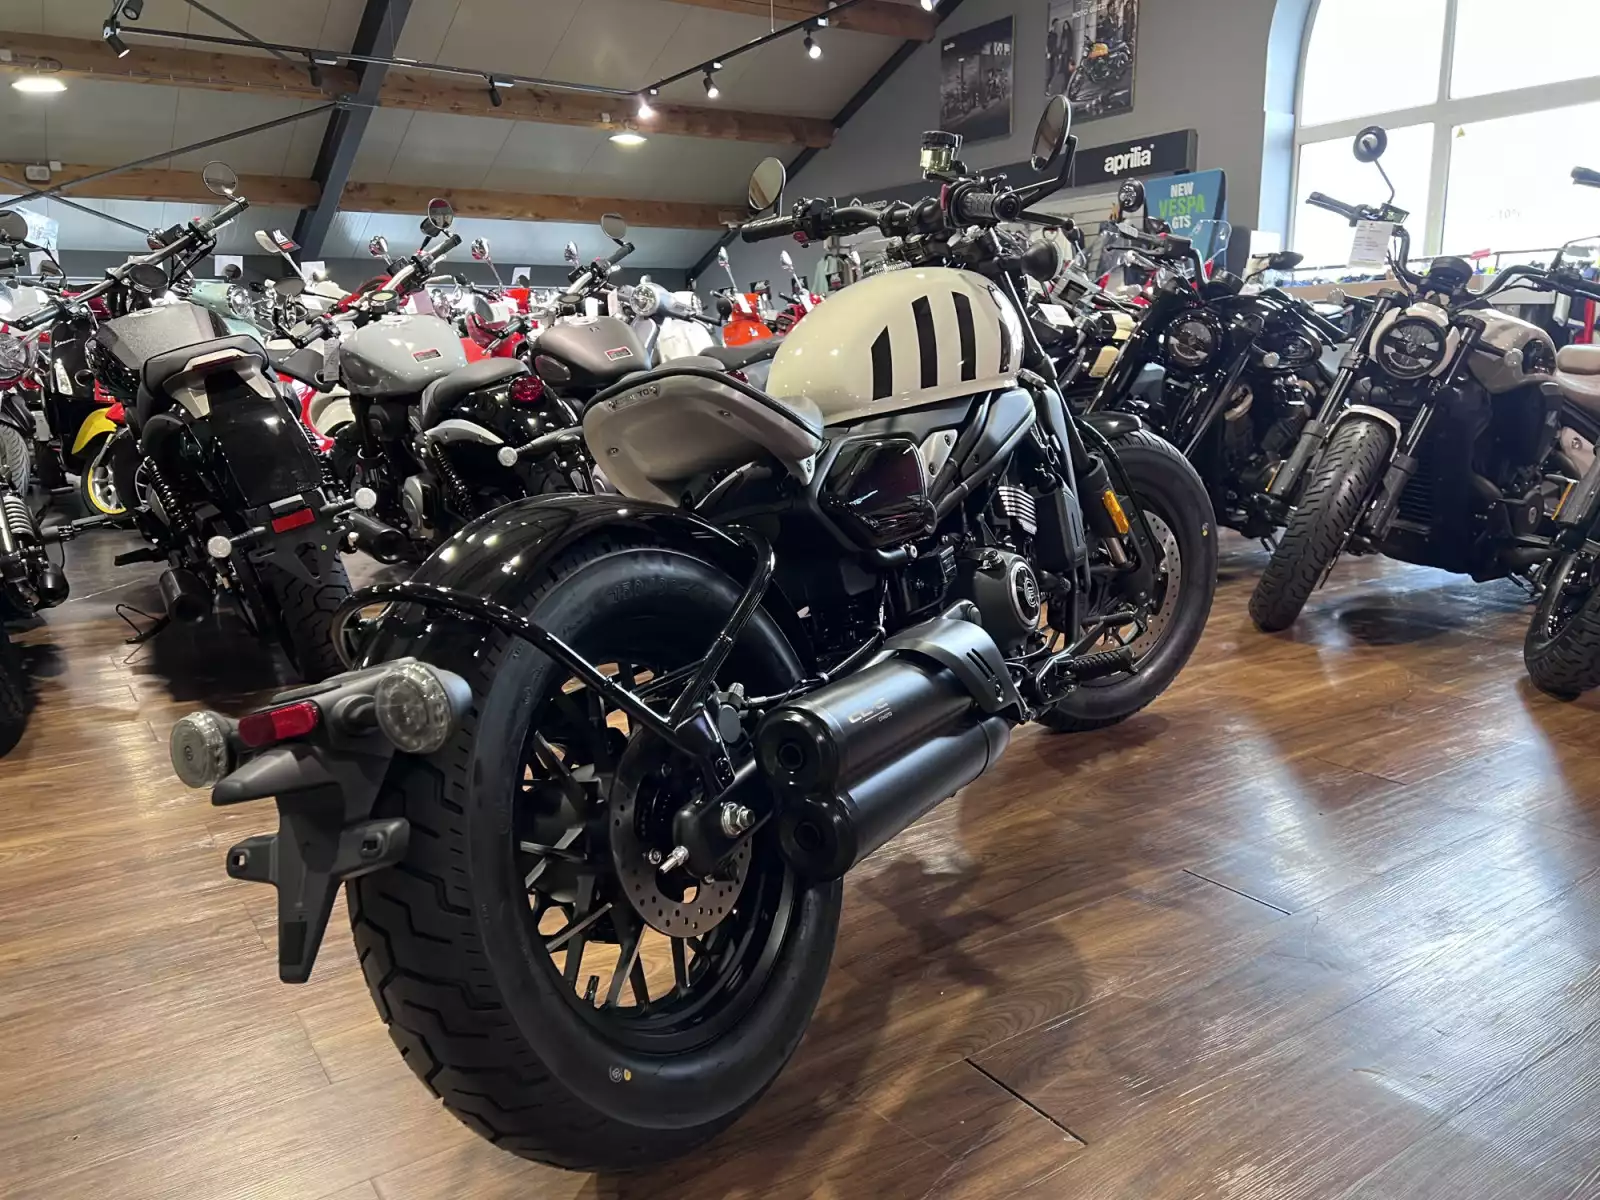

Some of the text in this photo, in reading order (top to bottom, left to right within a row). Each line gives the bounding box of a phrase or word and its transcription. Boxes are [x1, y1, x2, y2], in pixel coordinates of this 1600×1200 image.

[1104, 146, 1151, 175] aprilia
[1170, 181, 1194, 198] NEW
[1158, 194, 1206, 217] VESPA
[1171, 215, 1192, 230] GTS
